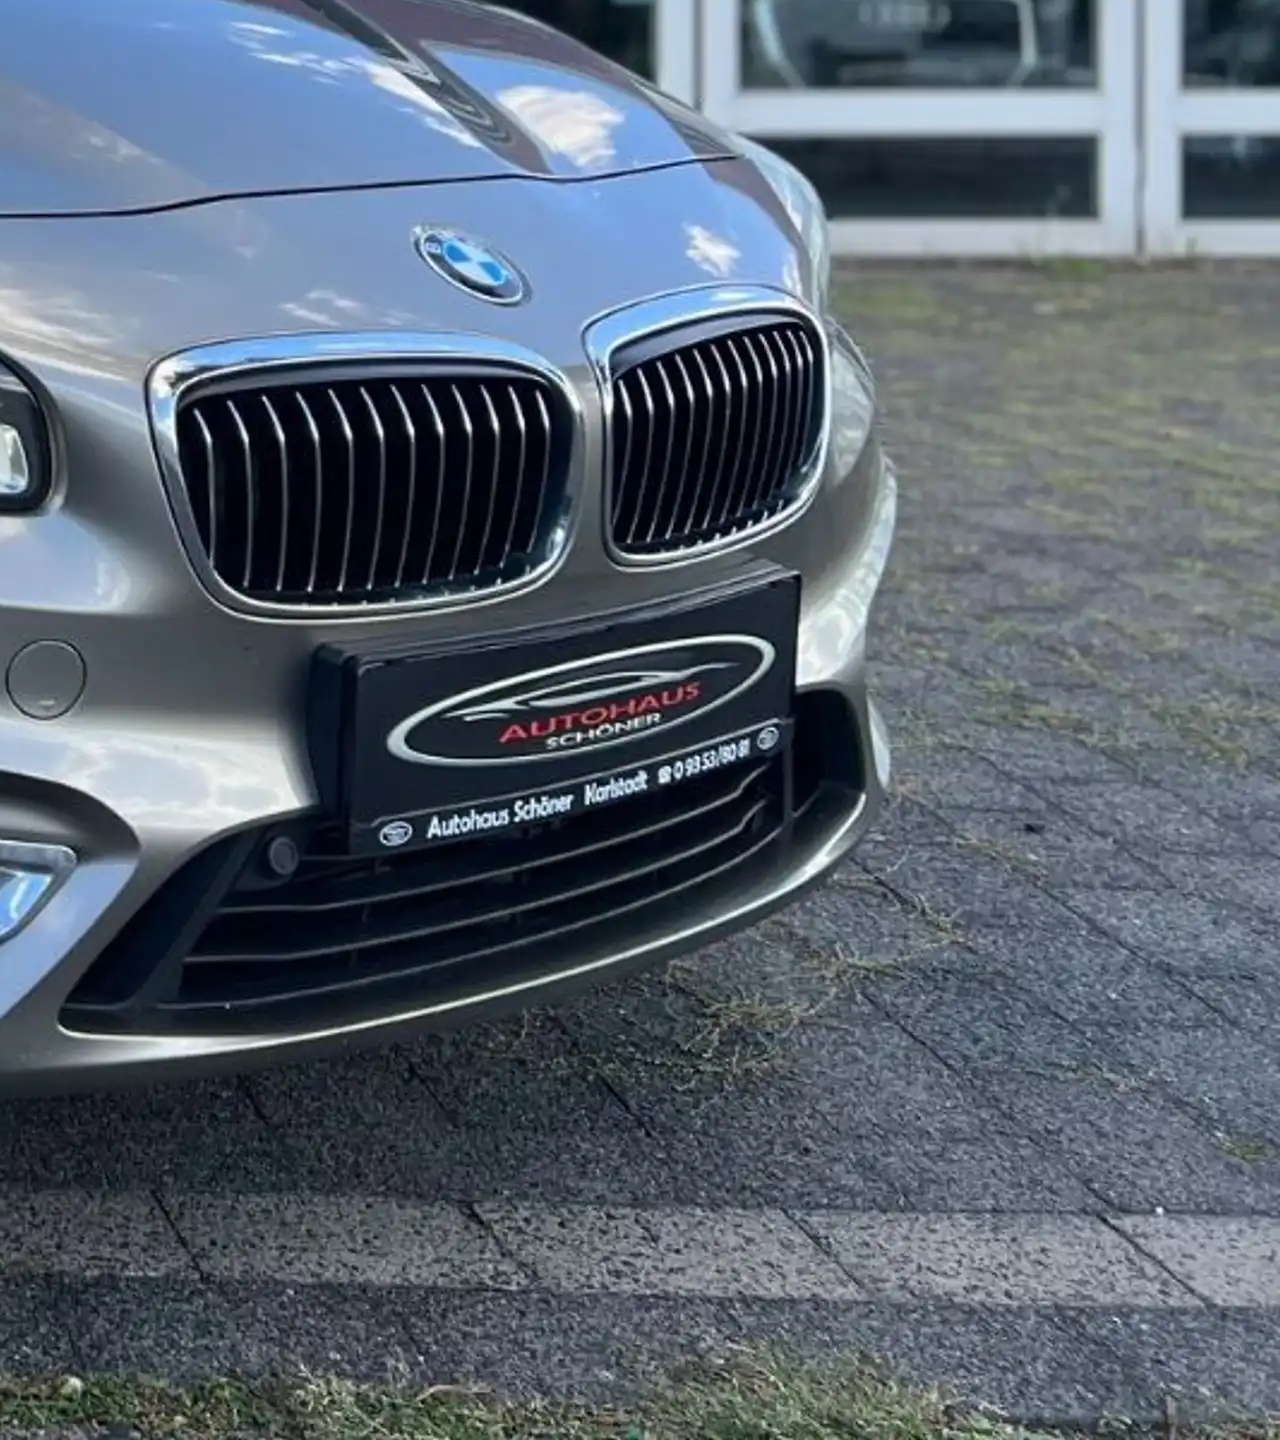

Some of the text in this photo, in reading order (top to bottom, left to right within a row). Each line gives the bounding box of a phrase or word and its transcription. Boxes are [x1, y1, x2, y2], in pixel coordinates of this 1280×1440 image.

[499, 681, 701, 743] AUTOHAUS
[544, 711, 662, 750] SCHÖNER
[425, 808, 510, 839] Autohaus
[513, 793, 574, 823] Schöner
[584, 769, 648, 806] Karlstadt
